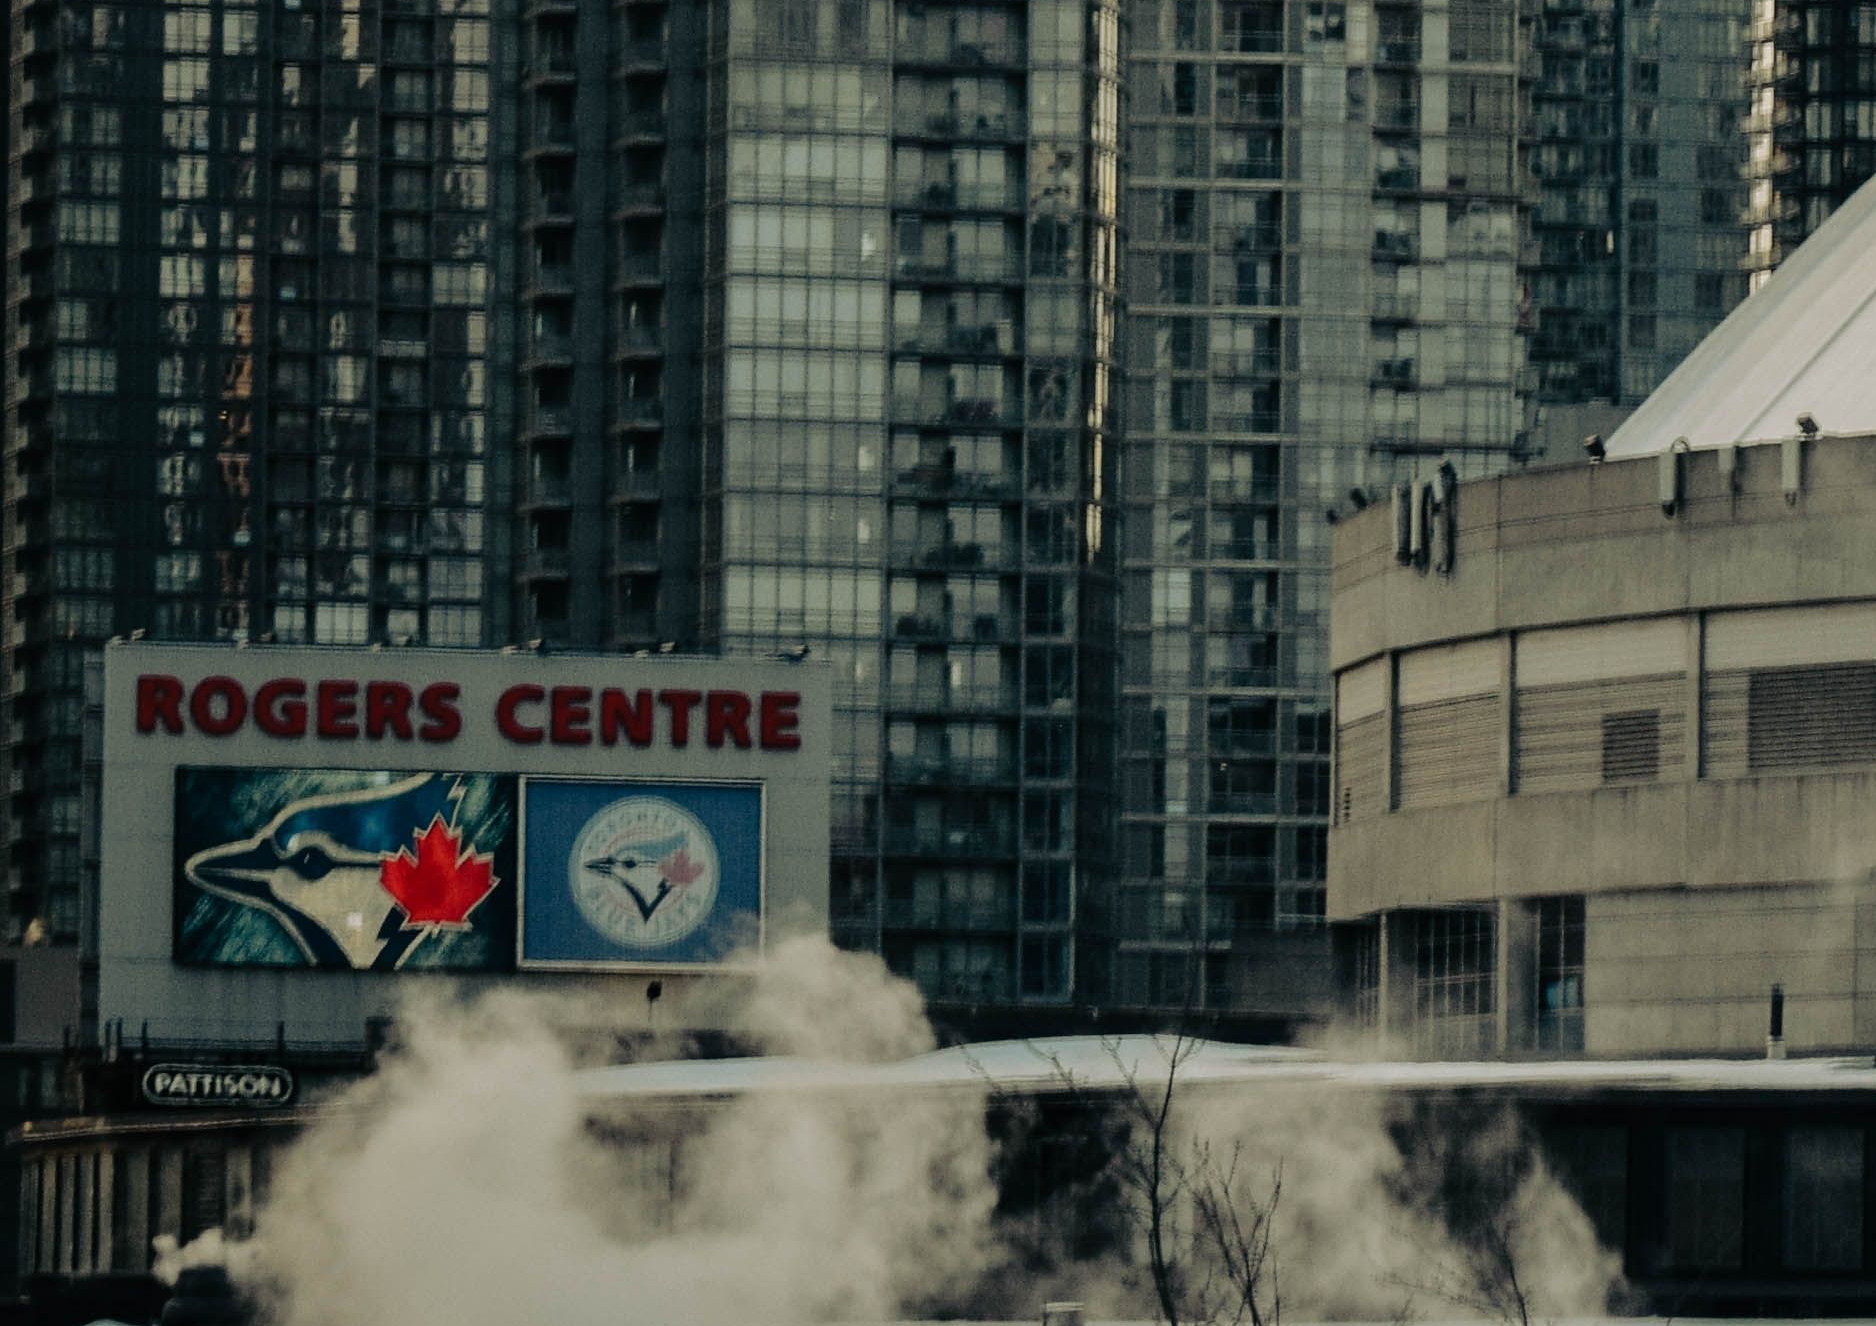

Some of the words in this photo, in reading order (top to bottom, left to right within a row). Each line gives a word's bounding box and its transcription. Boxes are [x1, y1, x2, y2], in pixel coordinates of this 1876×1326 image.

[136, 674, 463, 742] ROGERS
[497, 683, 802, 749] CENTRE
[154, 1072, 282, 1097] PATTISON
